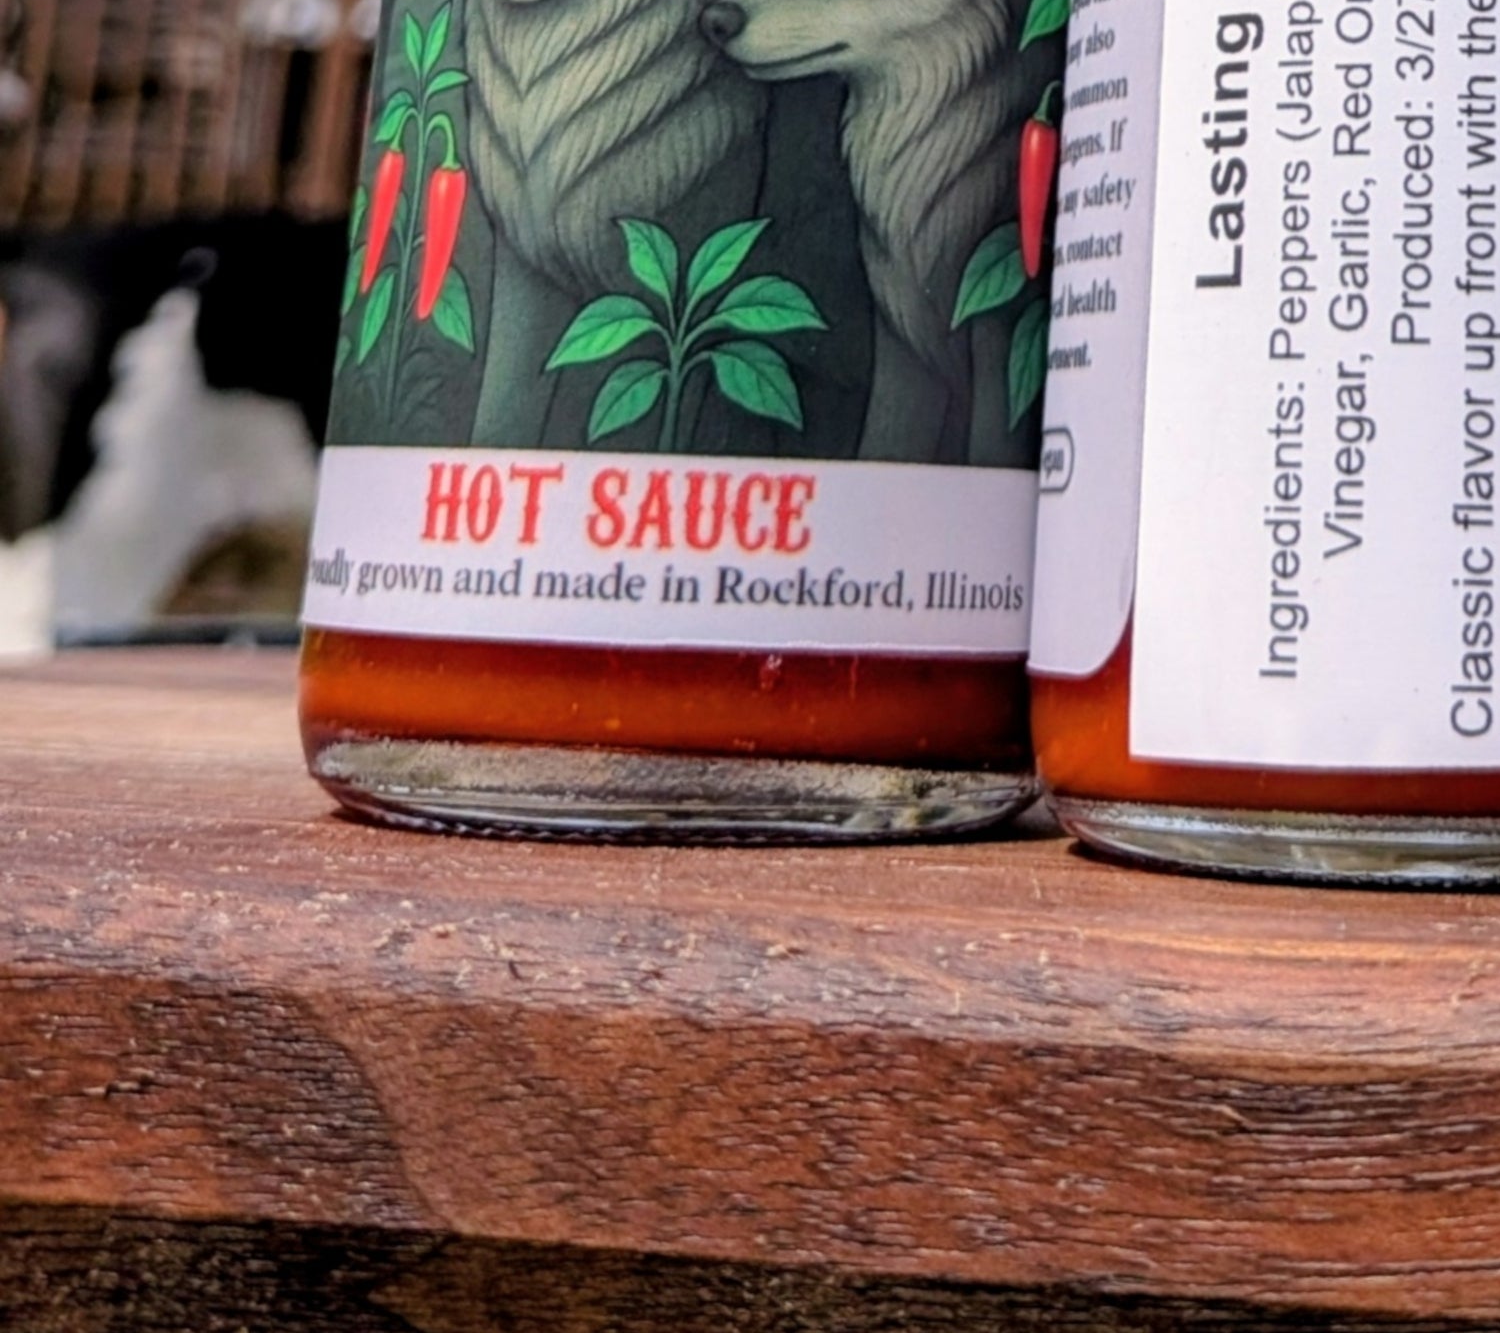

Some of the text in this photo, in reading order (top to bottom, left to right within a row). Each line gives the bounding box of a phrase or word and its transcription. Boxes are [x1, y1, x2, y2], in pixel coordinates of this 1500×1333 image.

[1086, 21, 1115, 56] also
[1110, 116, 1128, 152] If
[1195, 13, 1264, 289] Lasting
[1333, 63, 1373, 156] Red
[1457, 75, 1496, 169] with
[1082, 172, 1136, 211] safety
[1391, 102, 1434, 345] Produced:
[1455, 184, 1496, 296] front
[1066, 232, 1123, 264] contact
[1067, 278, 1117, 317] health
[1269, 160, 1317, 360] Peppers
[1328, 178, 1376, 332] Garlic,
[422, 462, 816, 554] HOT SAUCE
[1323, 354, 1376, 559] Vinegar,
[1452, 388, 1495, 531] flavor
[1259, 383, 1309, 678] Ingredients:
[356, 562, 443, 596] grown
[453, 558, 523, 597] and
[533, 561, 646, 602] made
[660, 565, 699, 604] in
[714, 566, 913, 612] Rockford,
[925, 571, 1024, 612] Illinois
[1450, 547, 1494, 738] Classic
